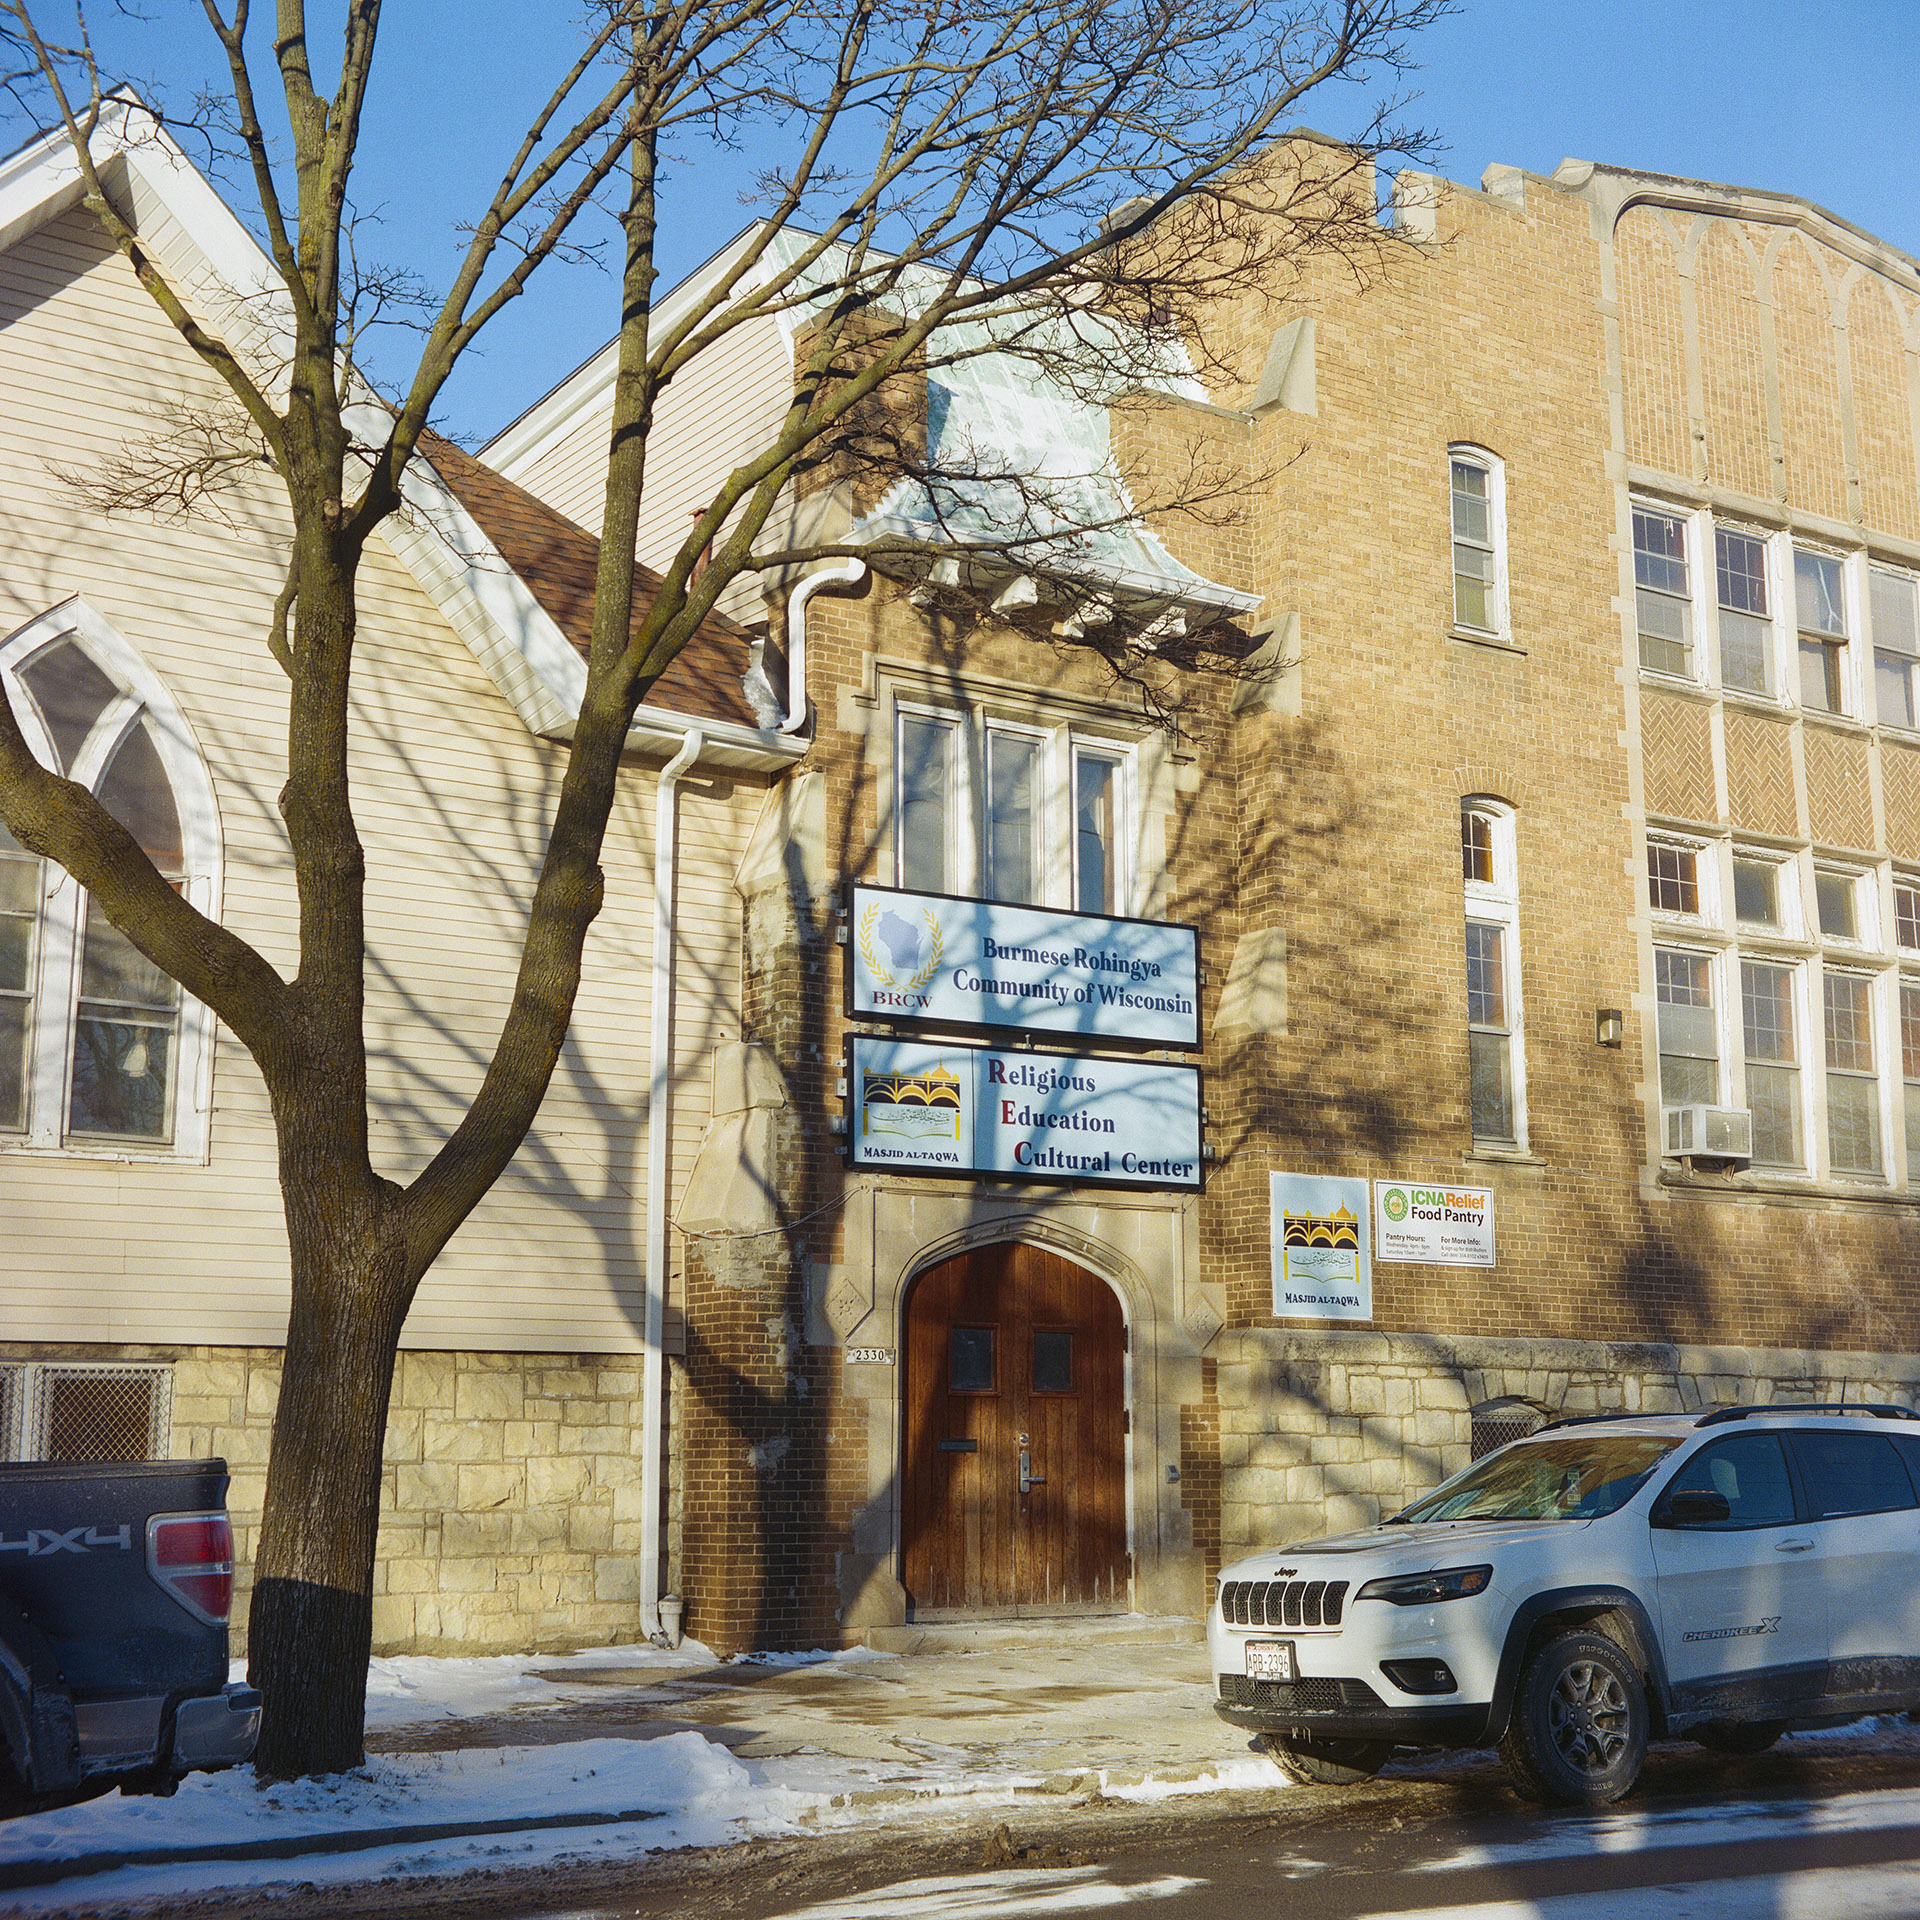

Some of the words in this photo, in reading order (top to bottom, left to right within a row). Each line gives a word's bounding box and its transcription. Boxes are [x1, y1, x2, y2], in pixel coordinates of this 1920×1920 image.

[983, 937, 1070, 967] Burmese
[1073, 948, 1161, 982] Rohingya
[872, 991, 933, 1008] BRCW
[953, 968, 1070, 1007] Community
[1074, 983, 1096, 1004] of
[1098, 984, 1193, 1014] Wisconsin
[988, 1058, 1096, 1095] Religious
[1001, 1099, 1116, 1134] Education
[864, 1147, 904, 1158] MASJID
[906, 1151, 959, 1162] AL-TAQWA
[1014, 1141, 1111, 1173] Cultural
[1121, 1152, 1193, 1178] Center
[1411, 1207, 1441, 1221] Food
[1445, 1209, 1484, 1227] Pantry
[1386, 1233, 1406, 1242] Pantry
[1406, 1234, 1426, 1242] Hours:
[1441, 1236, 1451, 1244] For
[1451, 1237, 1466, 1245] More
[1467, 1238, 1481, 1246] Info:
[1285, 1292, 1317, 1304] MASJID
[1317, 1296, 1360, 1307] AL-TAQWA
[856, 1350, 884, 1360] 2330
[1274, 1566, 1298, 1578] Jeep
[1248, 1653, 1289, 1672] ARB-2396
